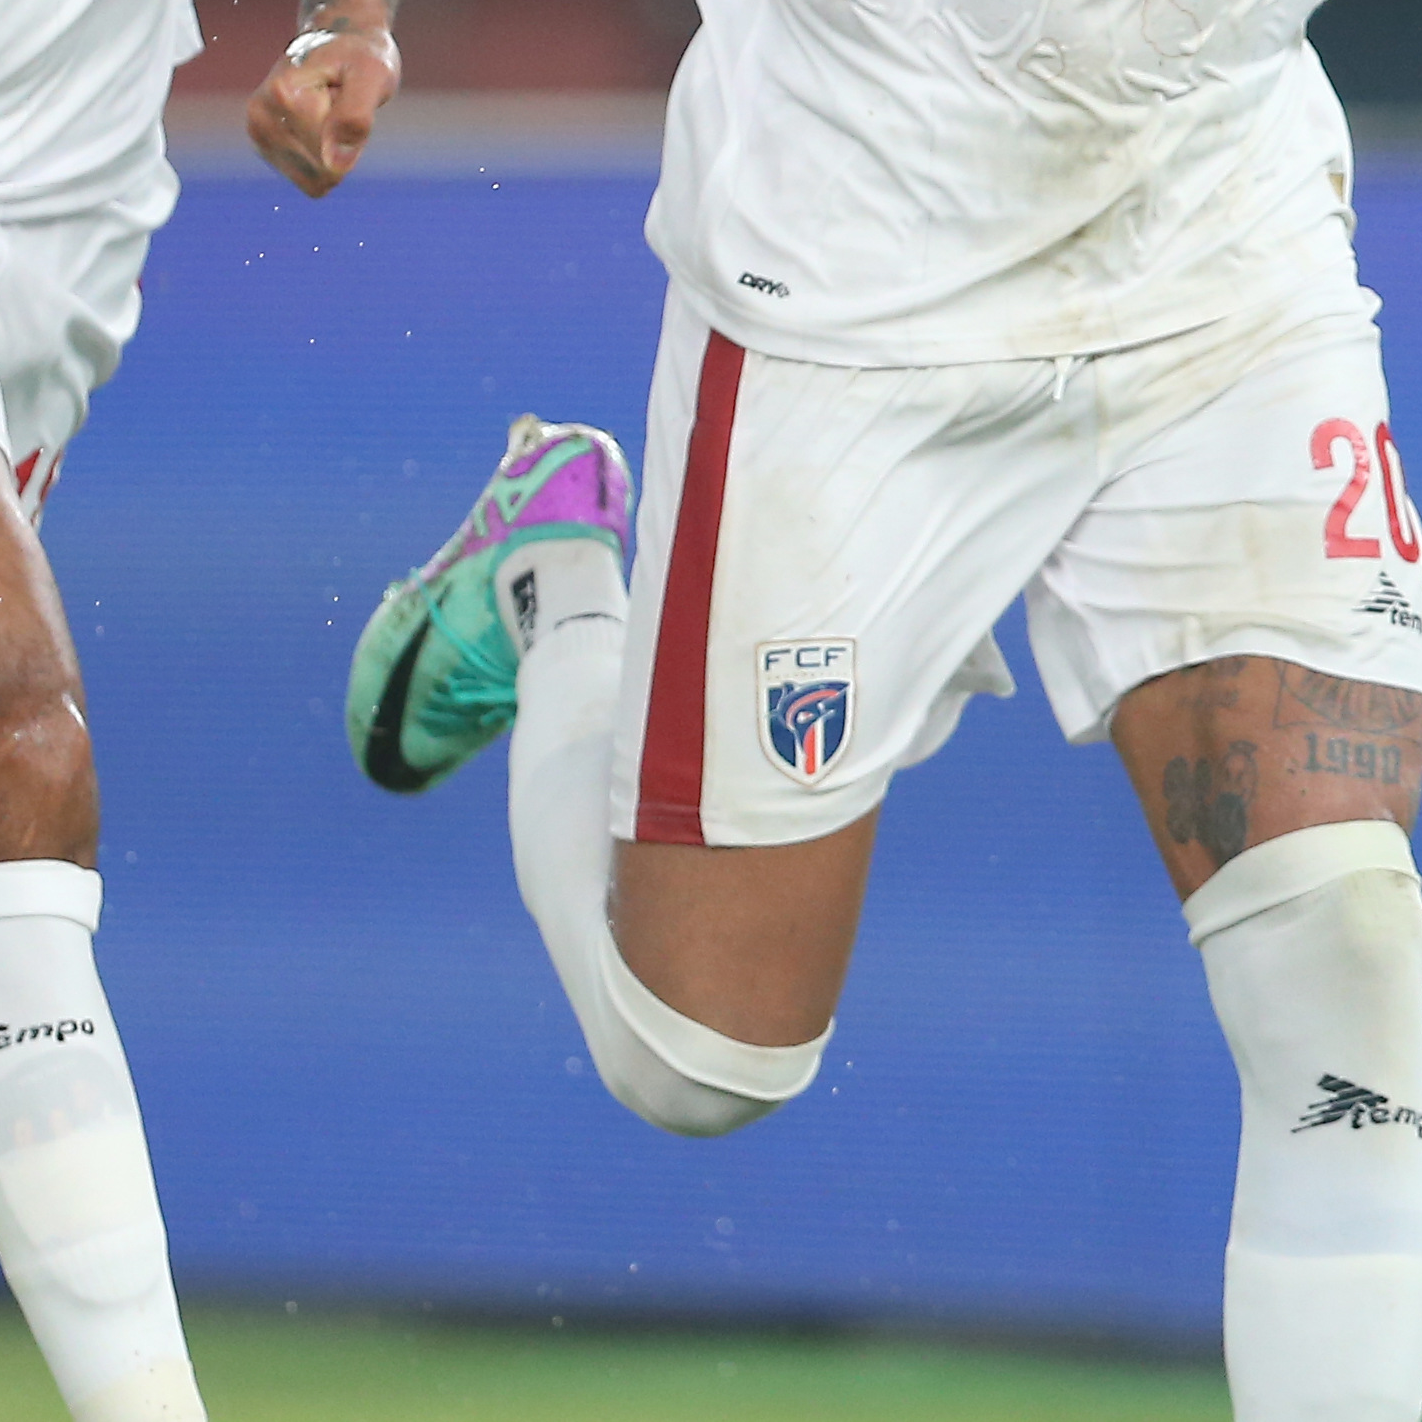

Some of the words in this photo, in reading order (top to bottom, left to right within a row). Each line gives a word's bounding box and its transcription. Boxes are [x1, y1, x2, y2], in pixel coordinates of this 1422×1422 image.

[1309, 417, 1420, 563] 20
[764, 647, 847, 671] FCF
[1303, 731, 1402, 785] 1990
